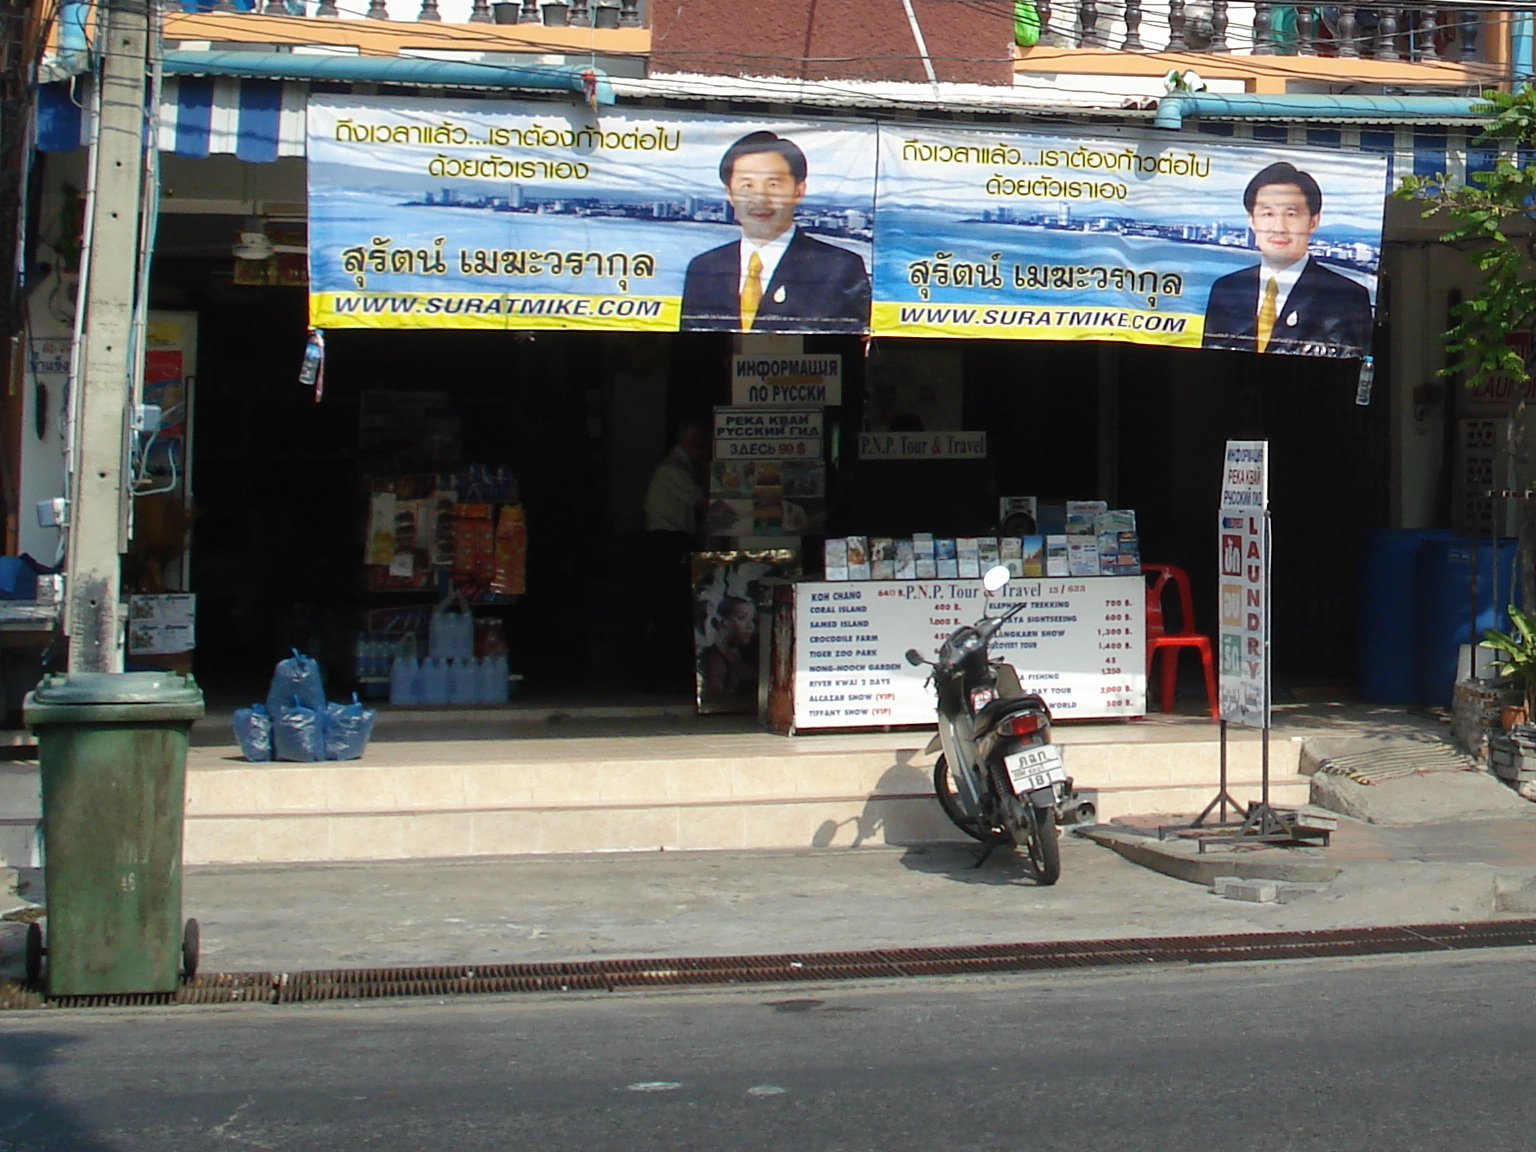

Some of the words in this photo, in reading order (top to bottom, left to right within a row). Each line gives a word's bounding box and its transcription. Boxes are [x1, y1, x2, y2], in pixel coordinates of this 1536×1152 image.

[428, 153, 590, 180] ด้วยตัวเราเอง
[985, 172, 1128, 200] ด้วยตัวเราเอง
[342, 236, 447, 290] สุรัตน์
[460, 249, 656, 292] เมฆะวรากุล
[908, 252, 1003, 302] สุรัตน์
[1014, 263, 1184, 309] เมฆะวรากุล
[335, 297, 663, 317] WWW.SURATMIKE.COM
[899, 307, 1188, 333] WWW.SURATMIKE.COM
[749, 385, 768, 403] ПО
[771, 385, 826, 403] РУССКИ
[726, 415, 764, 426] РЕКА
[790, 426, 820, 436] ГИД
[730, 443, 775, 455] ЗДЕСЬ
[901, 437, 926, 454] Tour
[931, 436, 942, 454] &
[947, 436, 984, 454] Travel
[811, 592, 830, 602] KOH
[833, 591, 862, 601] CHANG
[905, 584, 944, 600] P.N.P.
[948, 584, 979, 599] Tour
[1001, 583, 1041, 598] Travel
[1246, 516, 1260, 681] LAUNDRY
[810, 606, 835, 614] CORAL
[838, 605, 867, 613] ISLAND
[934, 603, 951, 611] 400
[989, 601, 1027, 610] ELEPHAT
[840, 620, 869, 628] ISLAND
[1027, 615, 1078, 623] SIGHTSEEING
[809, 635, 853, 643] CROCODILE
[855, 634, 878, 642] FARM
[994, 630, 1039, 638] LANGKARN
[1041, 629, 1066, 637] SHOW
[809, 650, 832, 658] TIGER
[855, 649, 877, 657] PARK
[809, 664, 866, 673] NONG-NOOCH
[868, 663, 902, 671] GARDEN
[1028, 673, 1060, 681] FISHING
[809, 680, 832, 688] RIVER
[835, 679, 858, 687] KWAI
[869, 678, 891, 686] DAYS
[1031, 687, 1048, 695] DAY
[1051, 687, 1072, 695] TOUR
[809, 695, 845, 703] ALCAZAR
[875, 692, 896, 701] (VIP)
[1048, 701, 1077, 709] WORLD
[809, 709, 842, 718] TIFFANY
[844, 708, 869, 716] SHOW
[872, 707, 892, 716] (VIP)
[1028, 773, 1053, 789] 181
